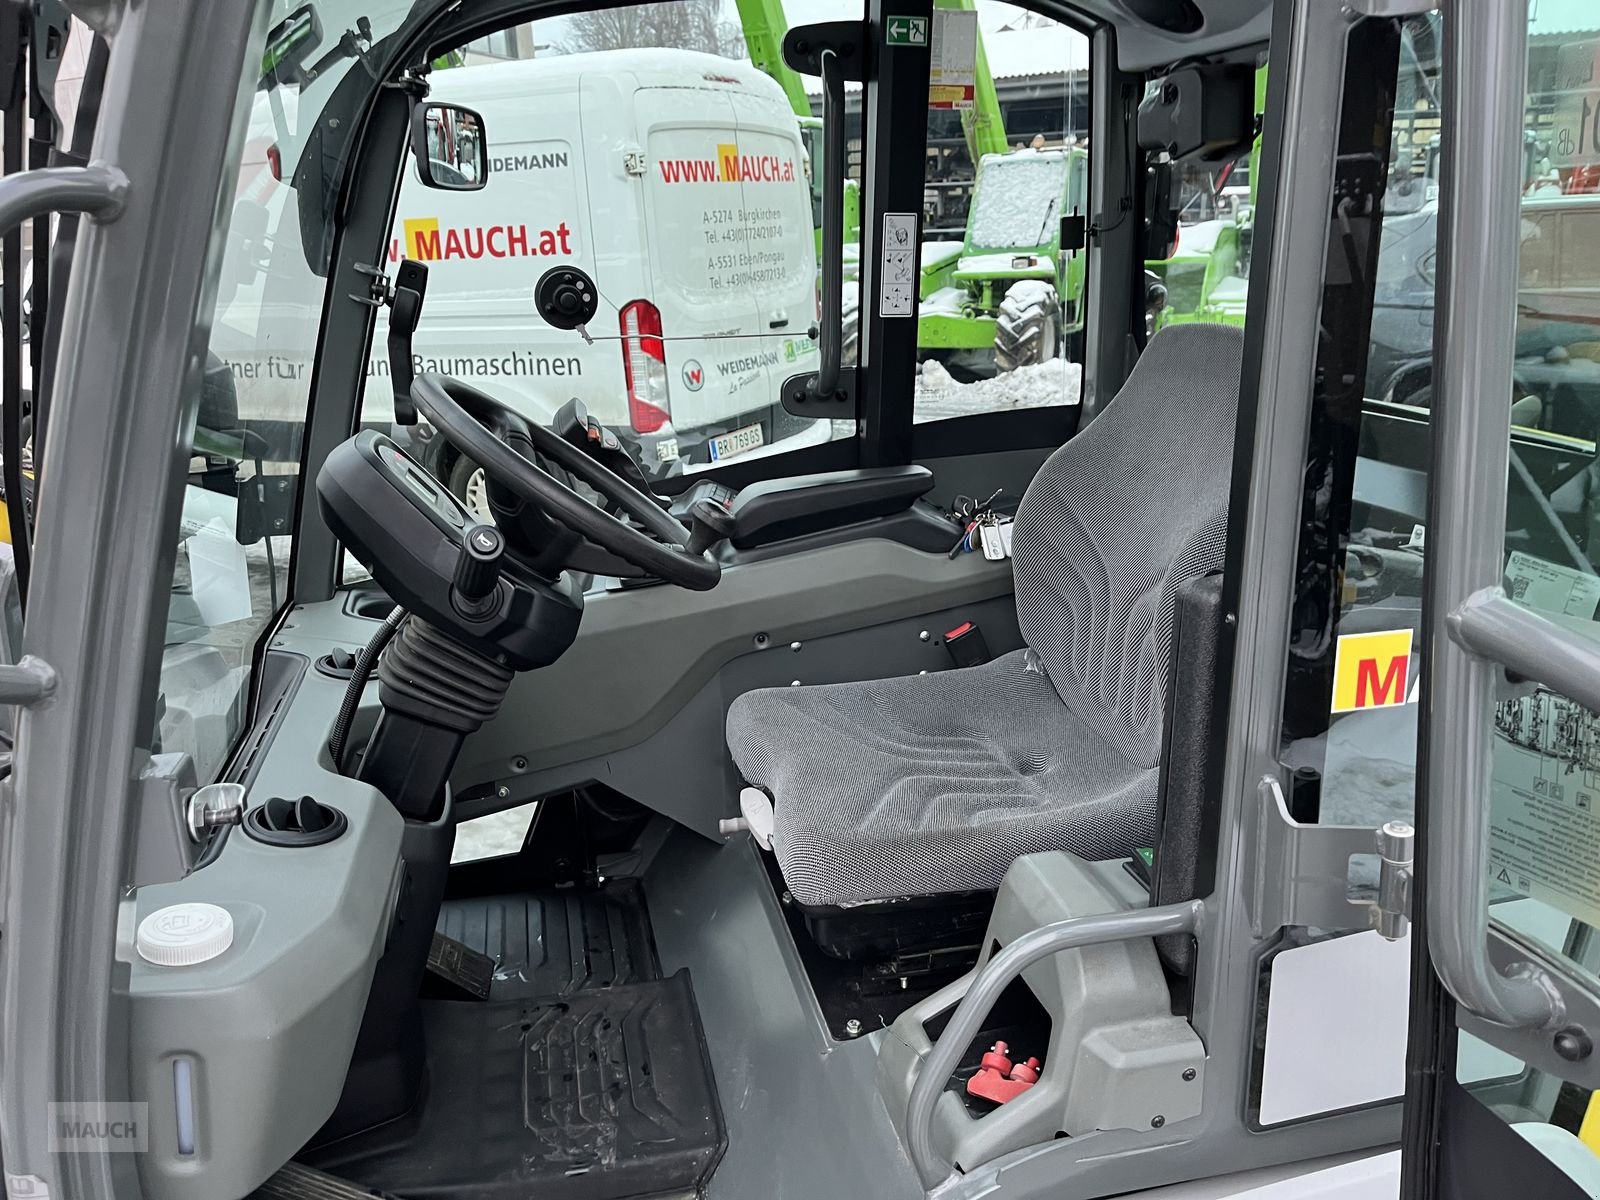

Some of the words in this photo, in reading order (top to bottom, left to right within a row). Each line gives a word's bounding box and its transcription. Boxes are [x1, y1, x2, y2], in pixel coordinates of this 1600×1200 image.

[488, 152, 568, 173] IDEMANN
[659, 156, 795, 183] www.MAUCH.at
[703, 209, 733, 224] A-5274
[738, 208, 781, 223] Burgkirchen
[705, 231, 719, 243] Tel.
[708, 256, 736, 270] A-5531
[739, 252, 785, 266] Eben/Pongau
[412, 351, 582, 376] Baumaschinen
[717, 352, 779, 376] WEIDEMANN
